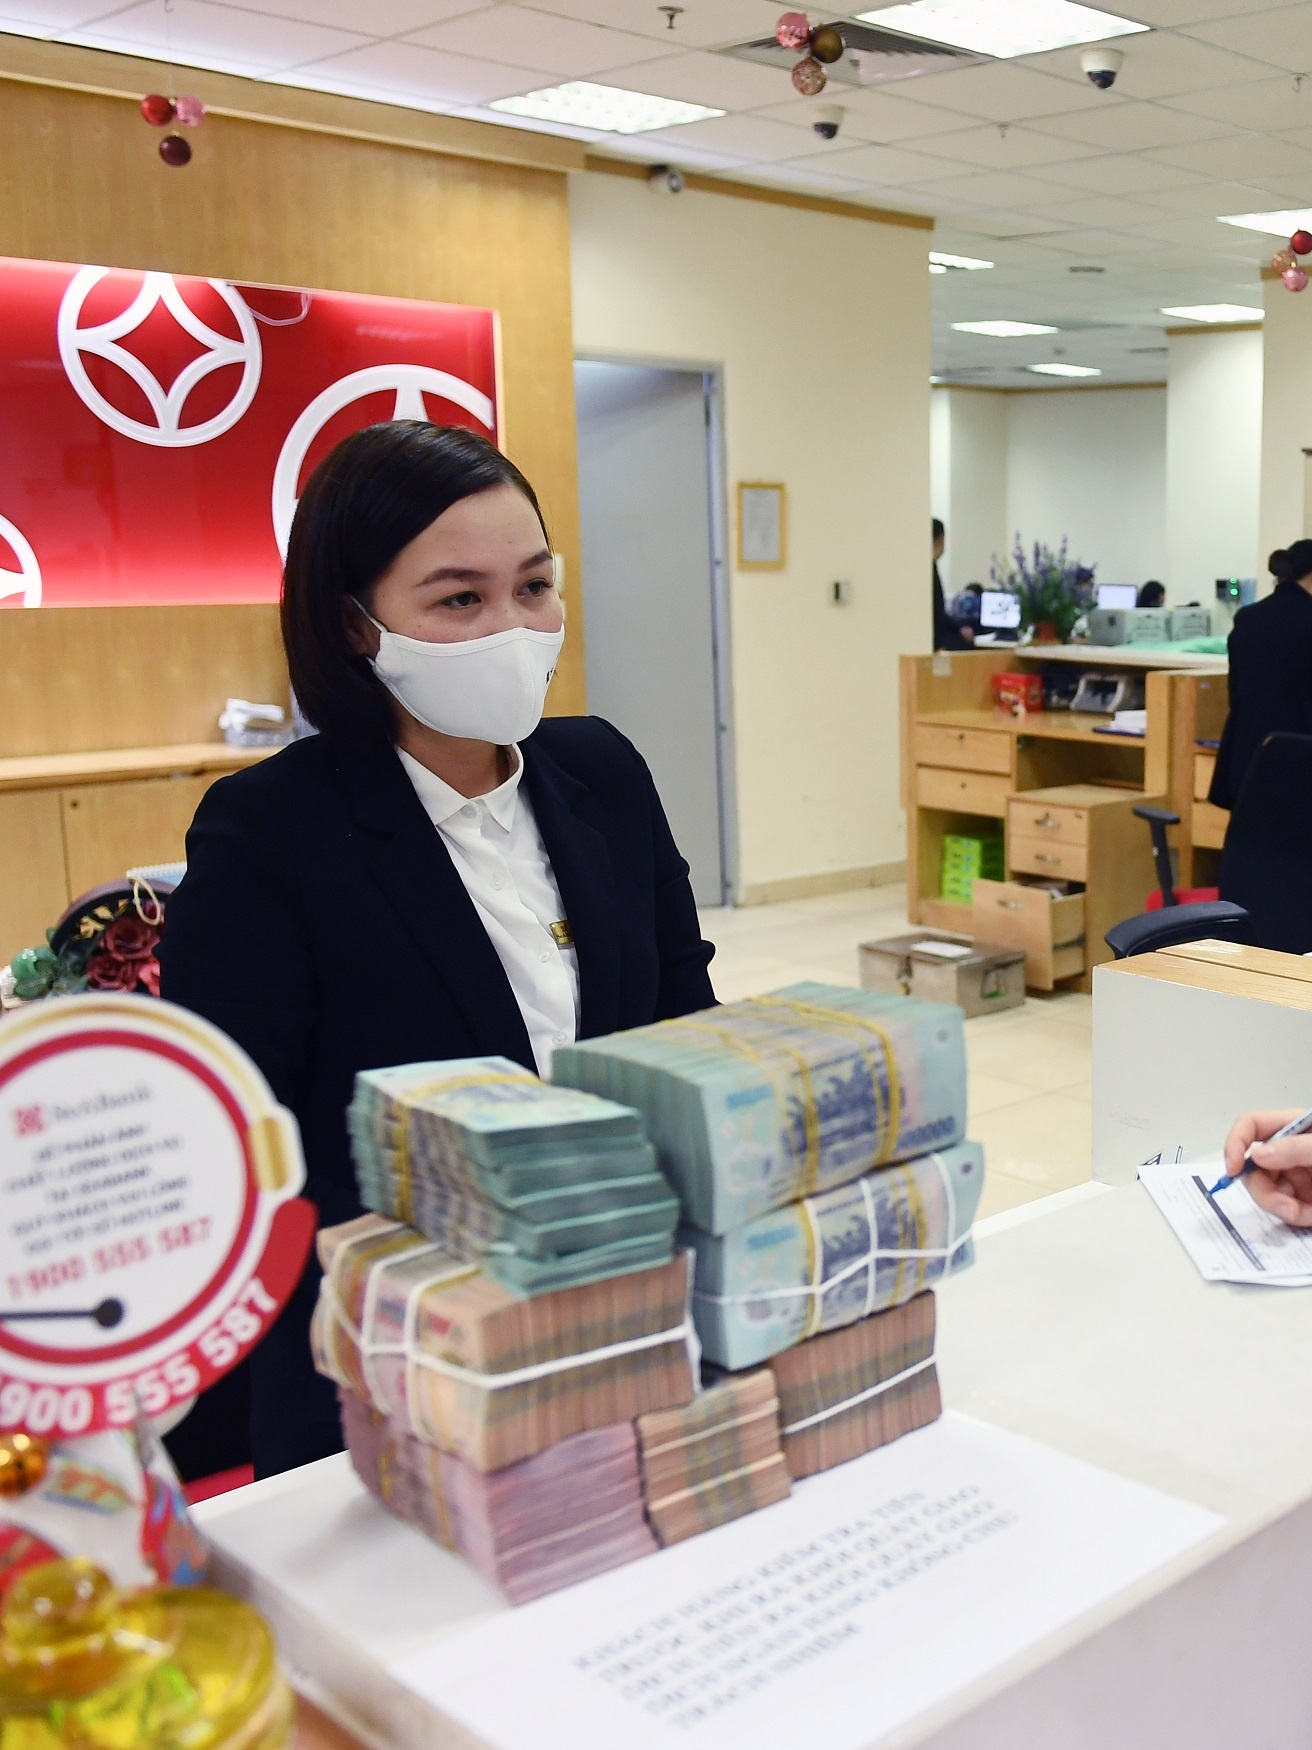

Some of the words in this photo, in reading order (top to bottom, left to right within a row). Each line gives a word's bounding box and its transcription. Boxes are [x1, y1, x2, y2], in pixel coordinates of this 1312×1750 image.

[157, 1214, 213, 1253] 587
[0, 1378, 94, 1433] 900
[104, 1353, 201, 1424] 555
[198, 1276, 278, 1368] 587
